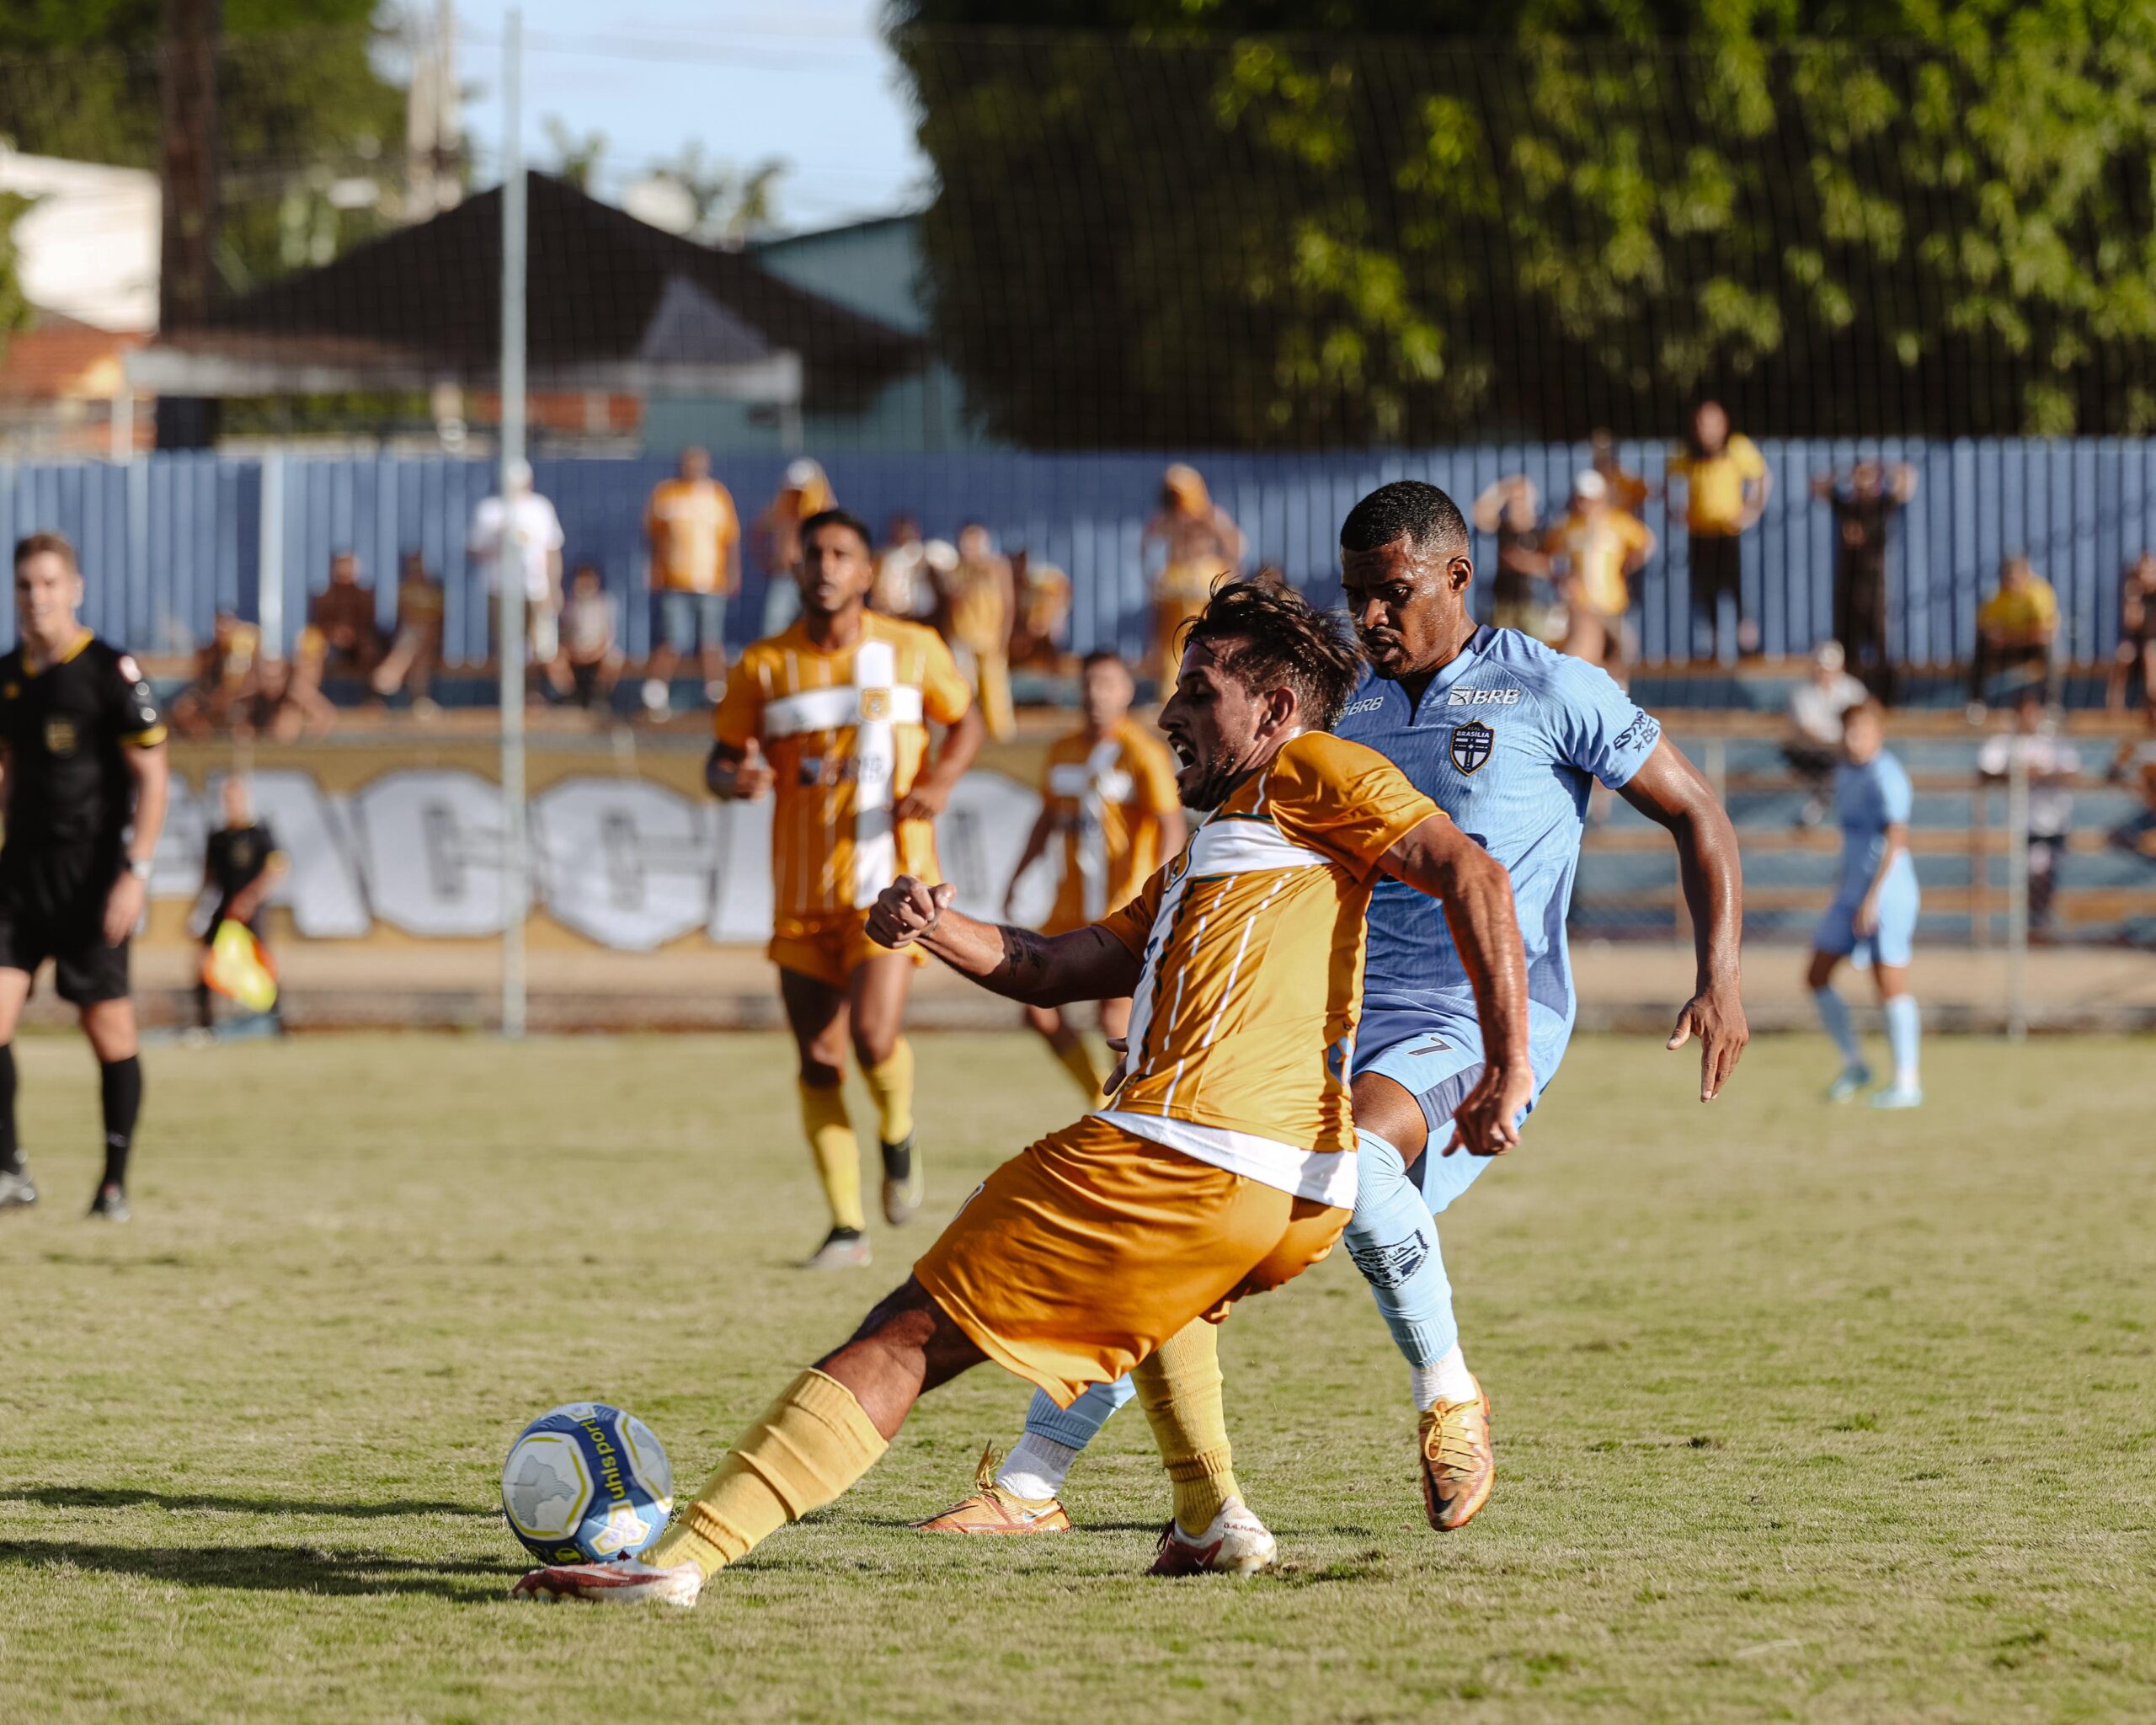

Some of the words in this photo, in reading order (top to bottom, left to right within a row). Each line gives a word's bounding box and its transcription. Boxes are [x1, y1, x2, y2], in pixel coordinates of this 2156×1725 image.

[1348, 696, 1384, 716] BRB
[1471, 688, 1521, 705] BRB
[1405, 1036, 1456, 1056] 7
[580, 1418, 626, 1500] uhlsport
